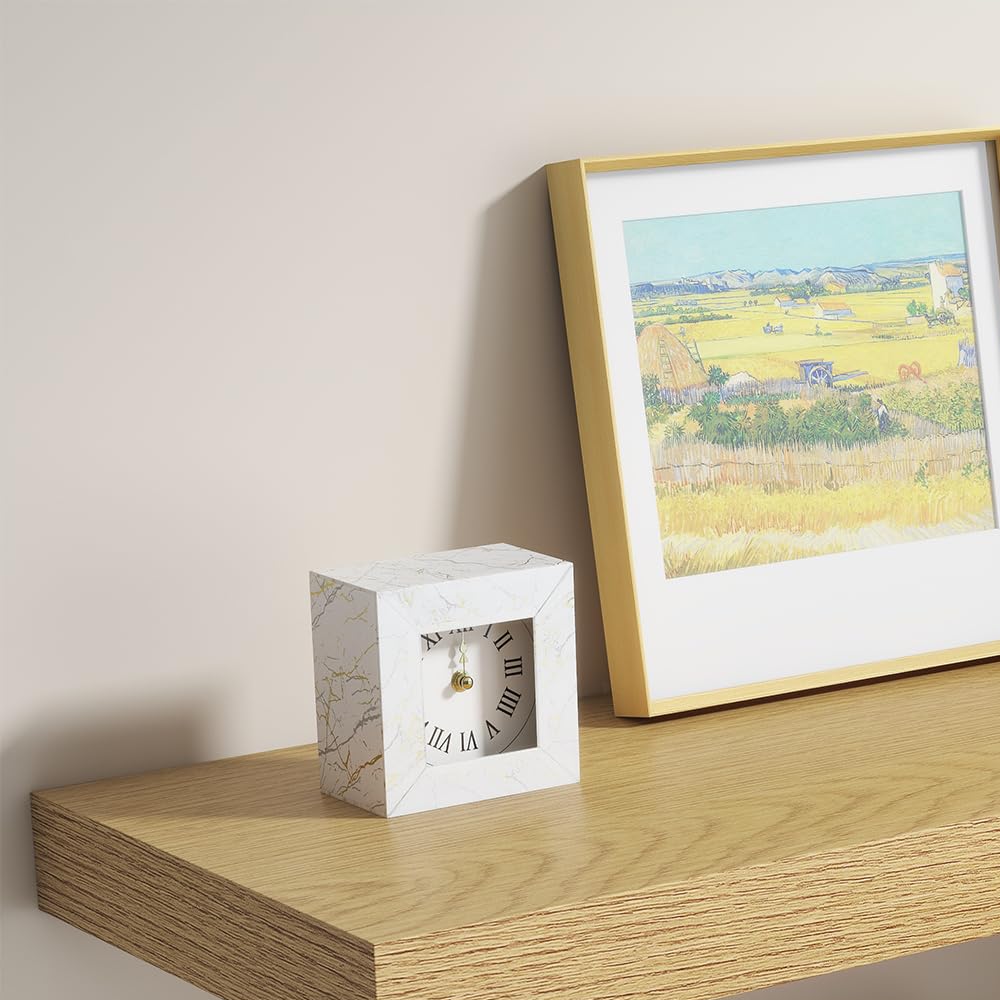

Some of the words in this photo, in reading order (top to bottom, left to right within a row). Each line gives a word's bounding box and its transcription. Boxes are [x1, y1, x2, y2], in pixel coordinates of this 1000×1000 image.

[493, 630, 514, 652] II
[504, 656, 523, 679] III
[496, 686, 522, 718] IIII
[485, 719, 501, 740] V
